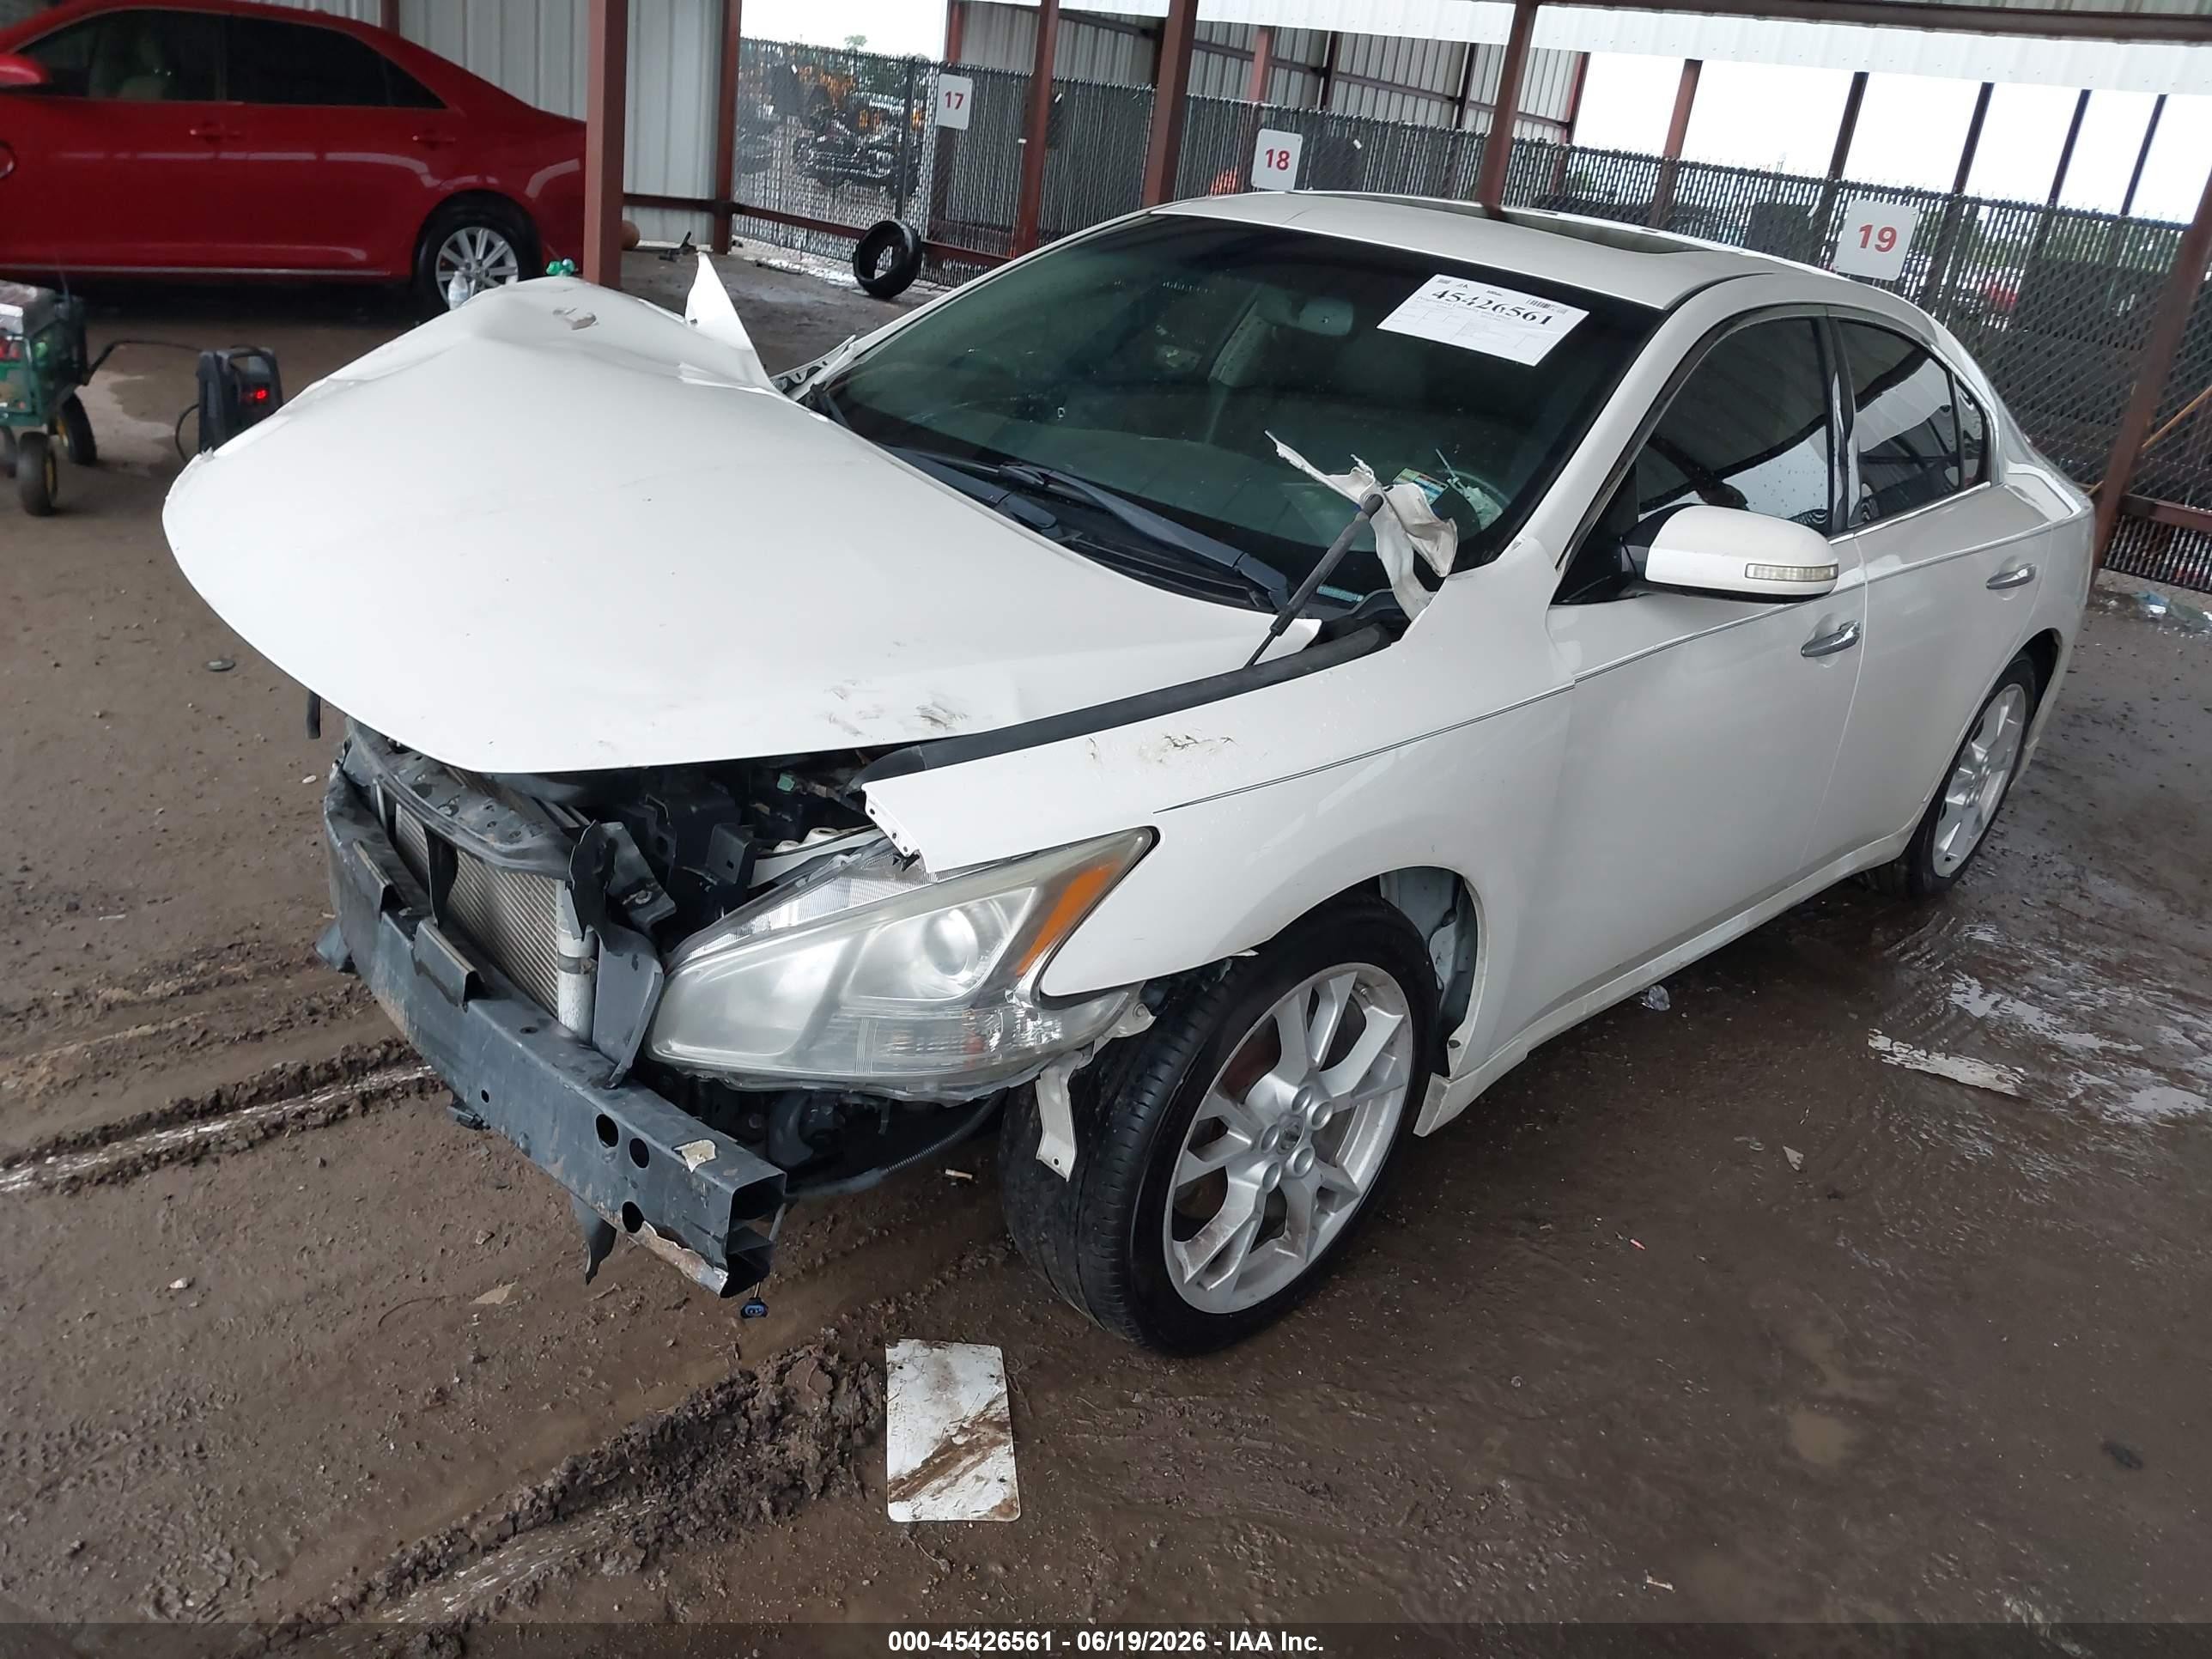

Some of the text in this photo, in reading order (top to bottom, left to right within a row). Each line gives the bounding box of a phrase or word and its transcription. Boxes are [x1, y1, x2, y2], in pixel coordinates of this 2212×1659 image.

[945, 90, 964, 110] 17
[1265, 148, 1291, 171] 18
[1858, 223, 1898, 253] 19
[1431, 289, 1553, 325] 45426561
